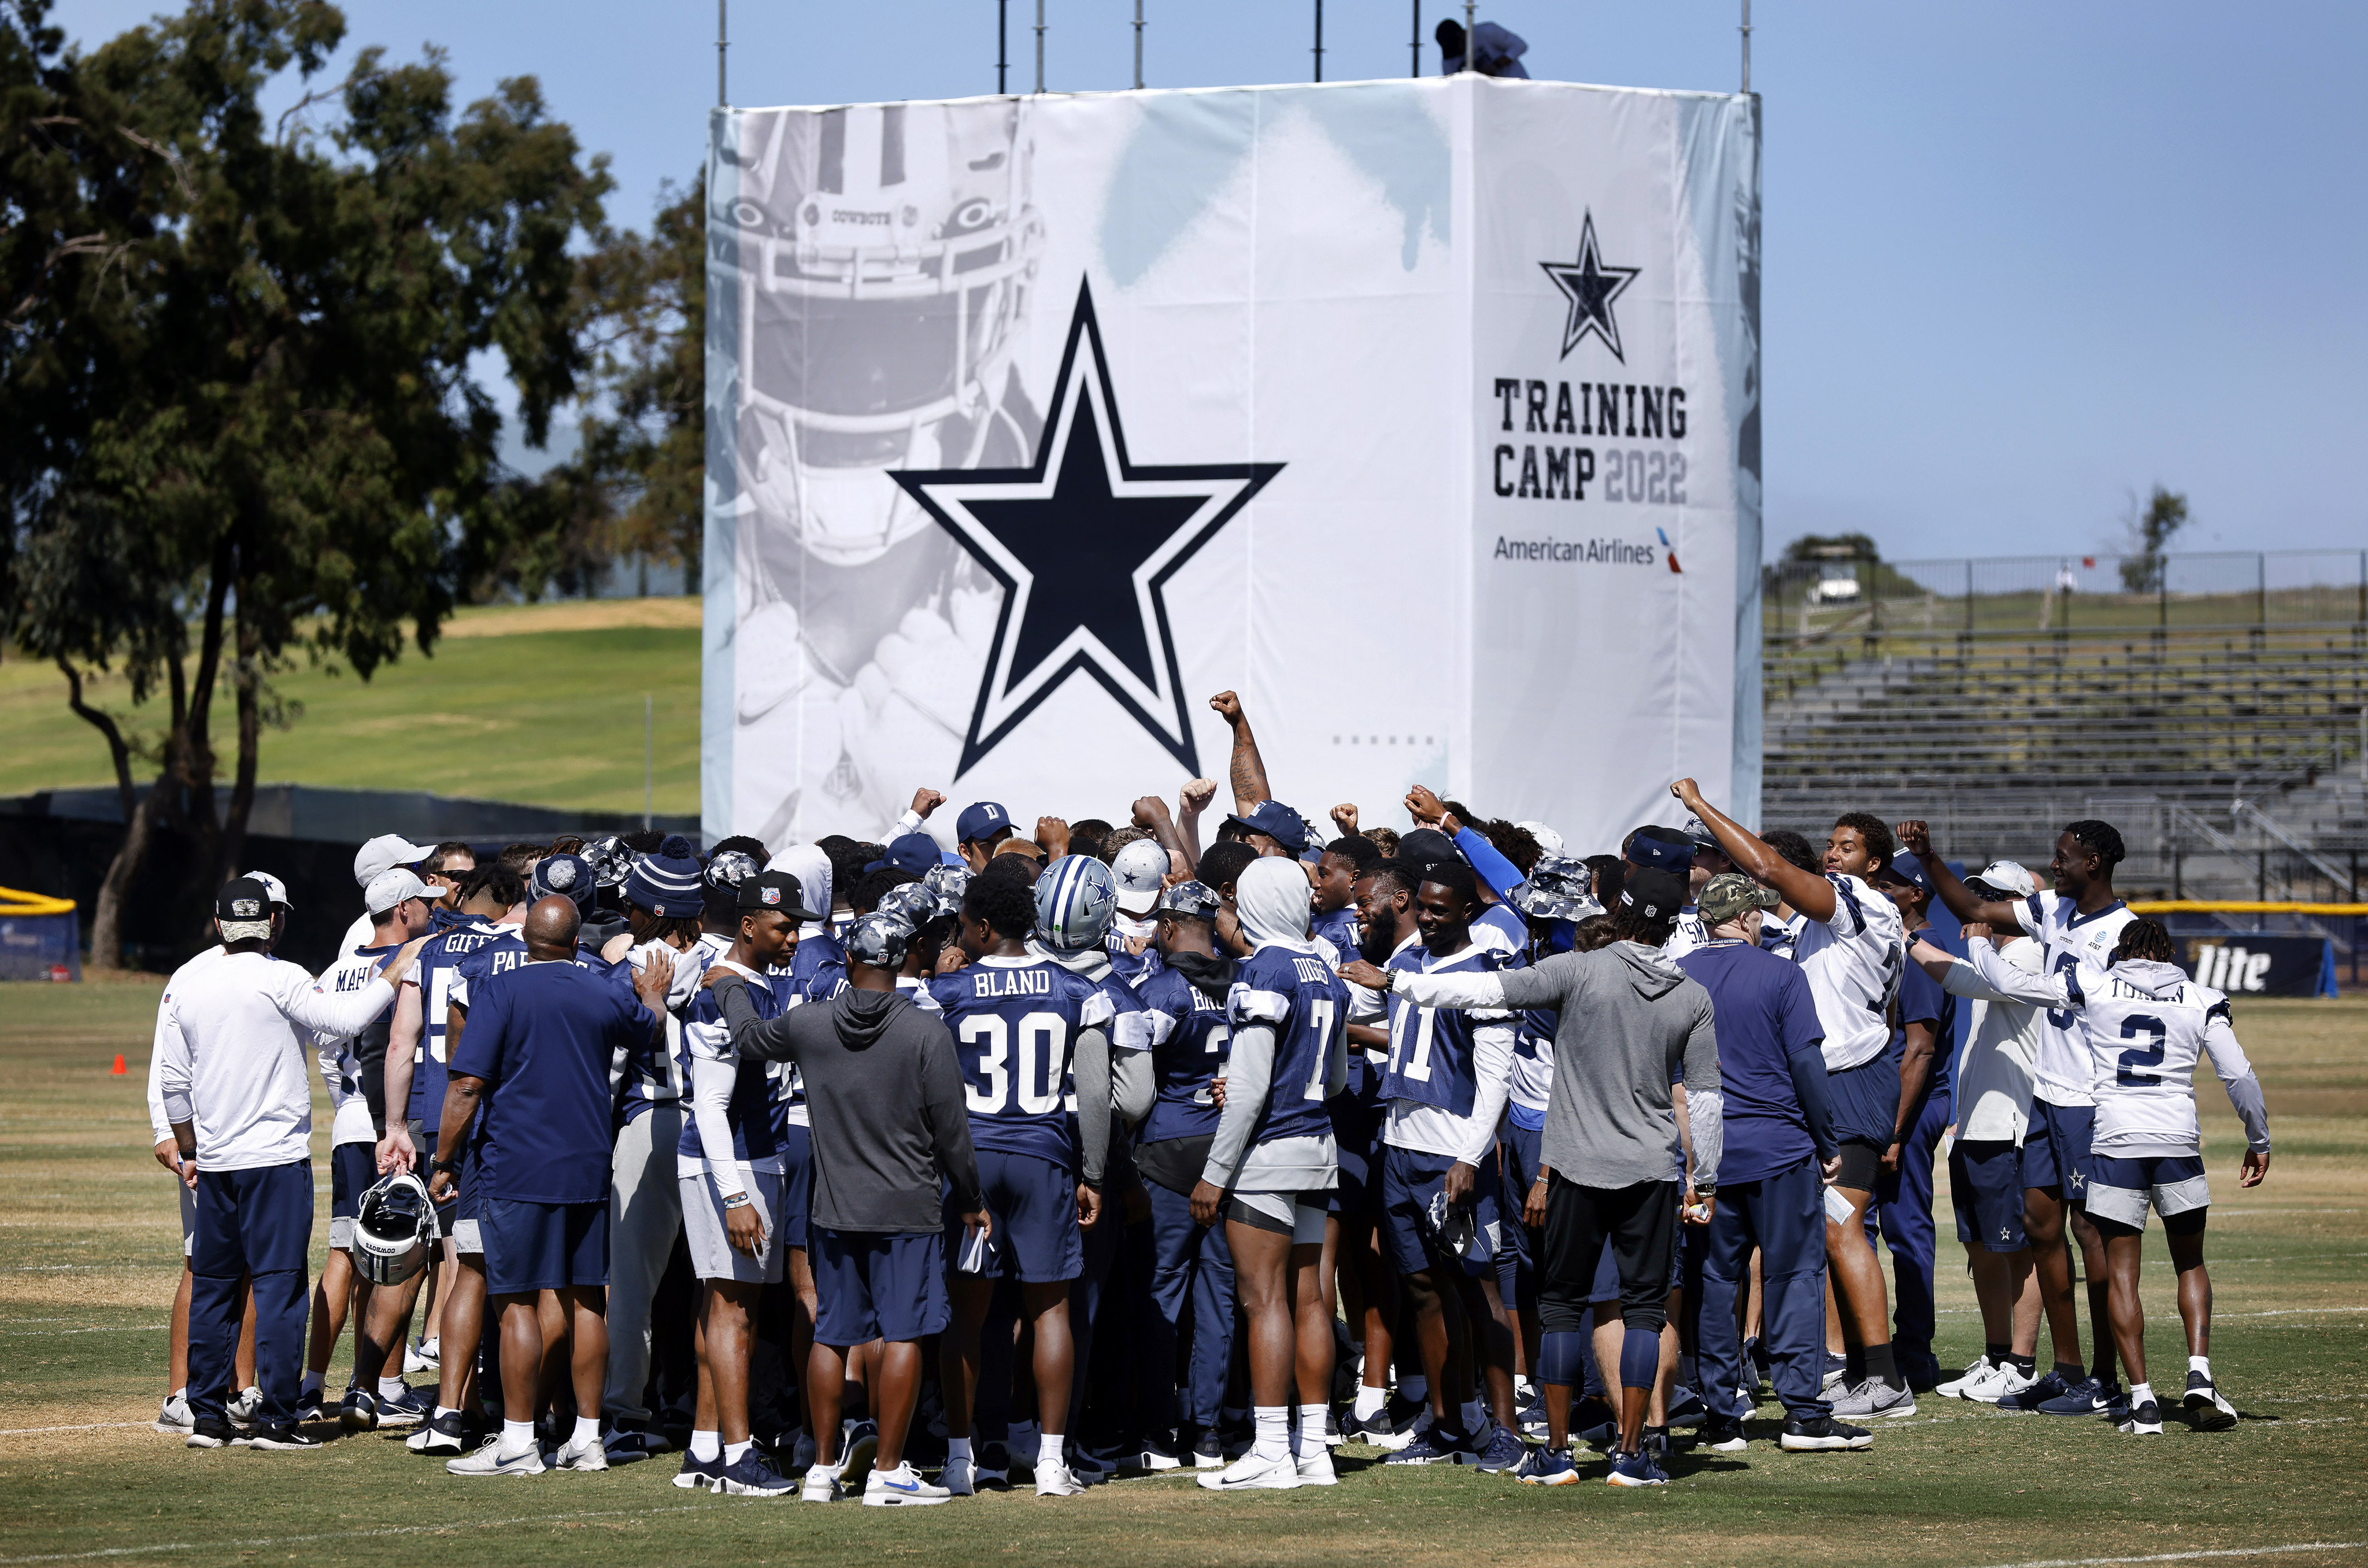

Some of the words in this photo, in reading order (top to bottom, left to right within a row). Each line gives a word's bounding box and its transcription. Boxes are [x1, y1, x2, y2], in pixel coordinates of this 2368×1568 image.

[1494, 378, 1686, 439] TRAINING
[1494, 444, 1595, 500] CAMP
[1604, 449, 1688, 504] 2022
[1494, 536, 1584, 563] American
[1586, 539, 1655, 564] Airlines
[983, 804, 1000, 820] D
[445, 933, 500, 953] GIFF
[2088, 941, 2102, 951] AT&T
[974, 970, 1050, 997] BLAND
[1304, 1000, 1333, 1102] 7
[1389, 998, 1436, 1082] 41
[2117, 1014, 2166, 1087] 2
[959, 1012, 1067, 1115] 30
[365, 1242, 395, 1254] COWBOYS
